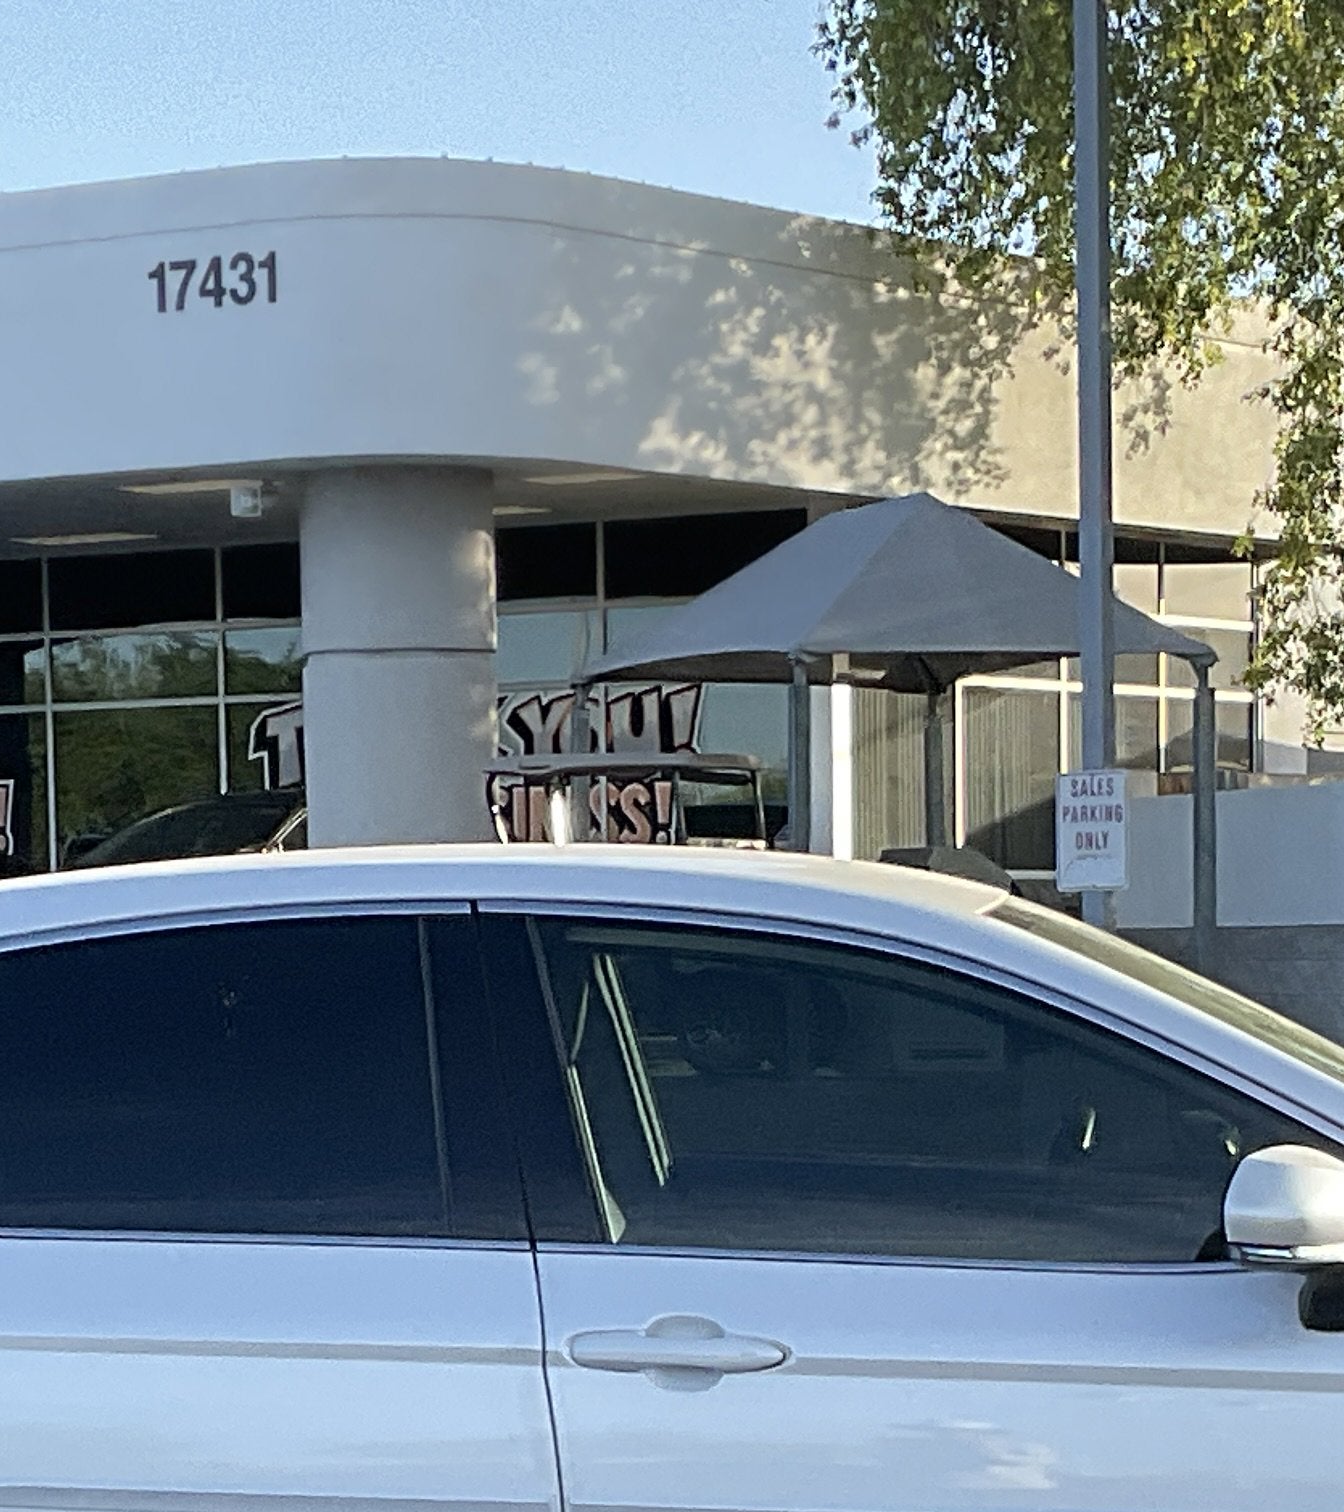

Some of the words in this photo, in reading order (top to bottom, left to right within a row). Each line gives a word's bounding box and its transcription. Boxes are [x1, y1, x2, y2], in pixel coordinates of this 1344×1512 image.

[147, 250, 277, 313] 17431
[1070, 777, 1114, 797] SALES
[1062, 804, 1124, 823] PARKING
[1075, 832, 1110, 851] ONLY
